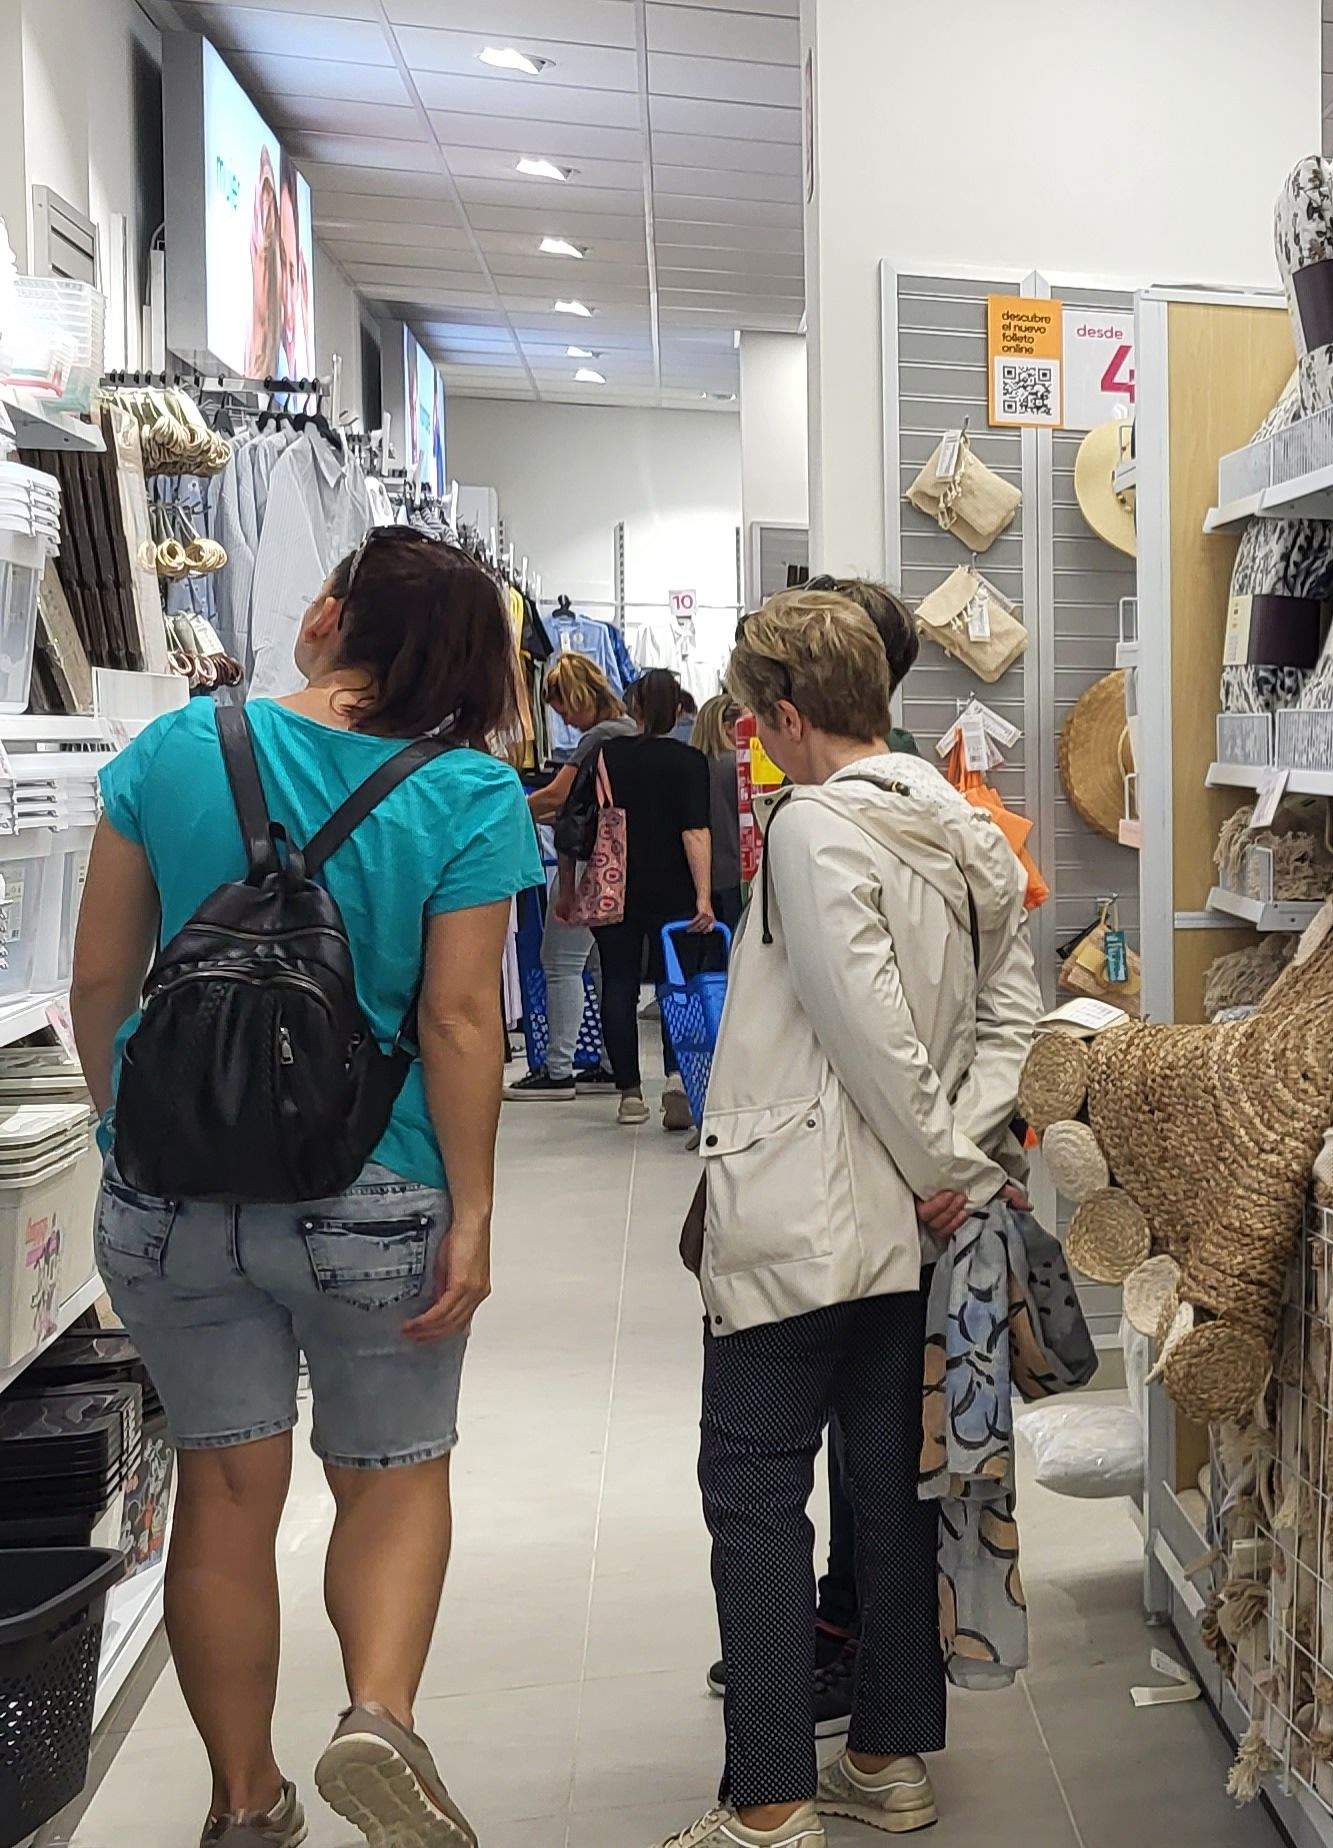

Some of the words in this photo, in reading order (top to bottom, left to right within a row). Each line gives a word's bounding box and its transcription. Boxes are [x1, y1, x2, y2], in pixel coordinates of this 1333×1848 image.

[1002, 310, 1051, 324] descubre
[1002, 323, 1011, 331] el
[1014, 326, 1046, 334] nuevo
[1077, 325, 1123, 339] desde
[1002, 334, 1034, 343] folleto
[1002, 345, 1034, 354] online
[672, 595, 693, 610] 10
